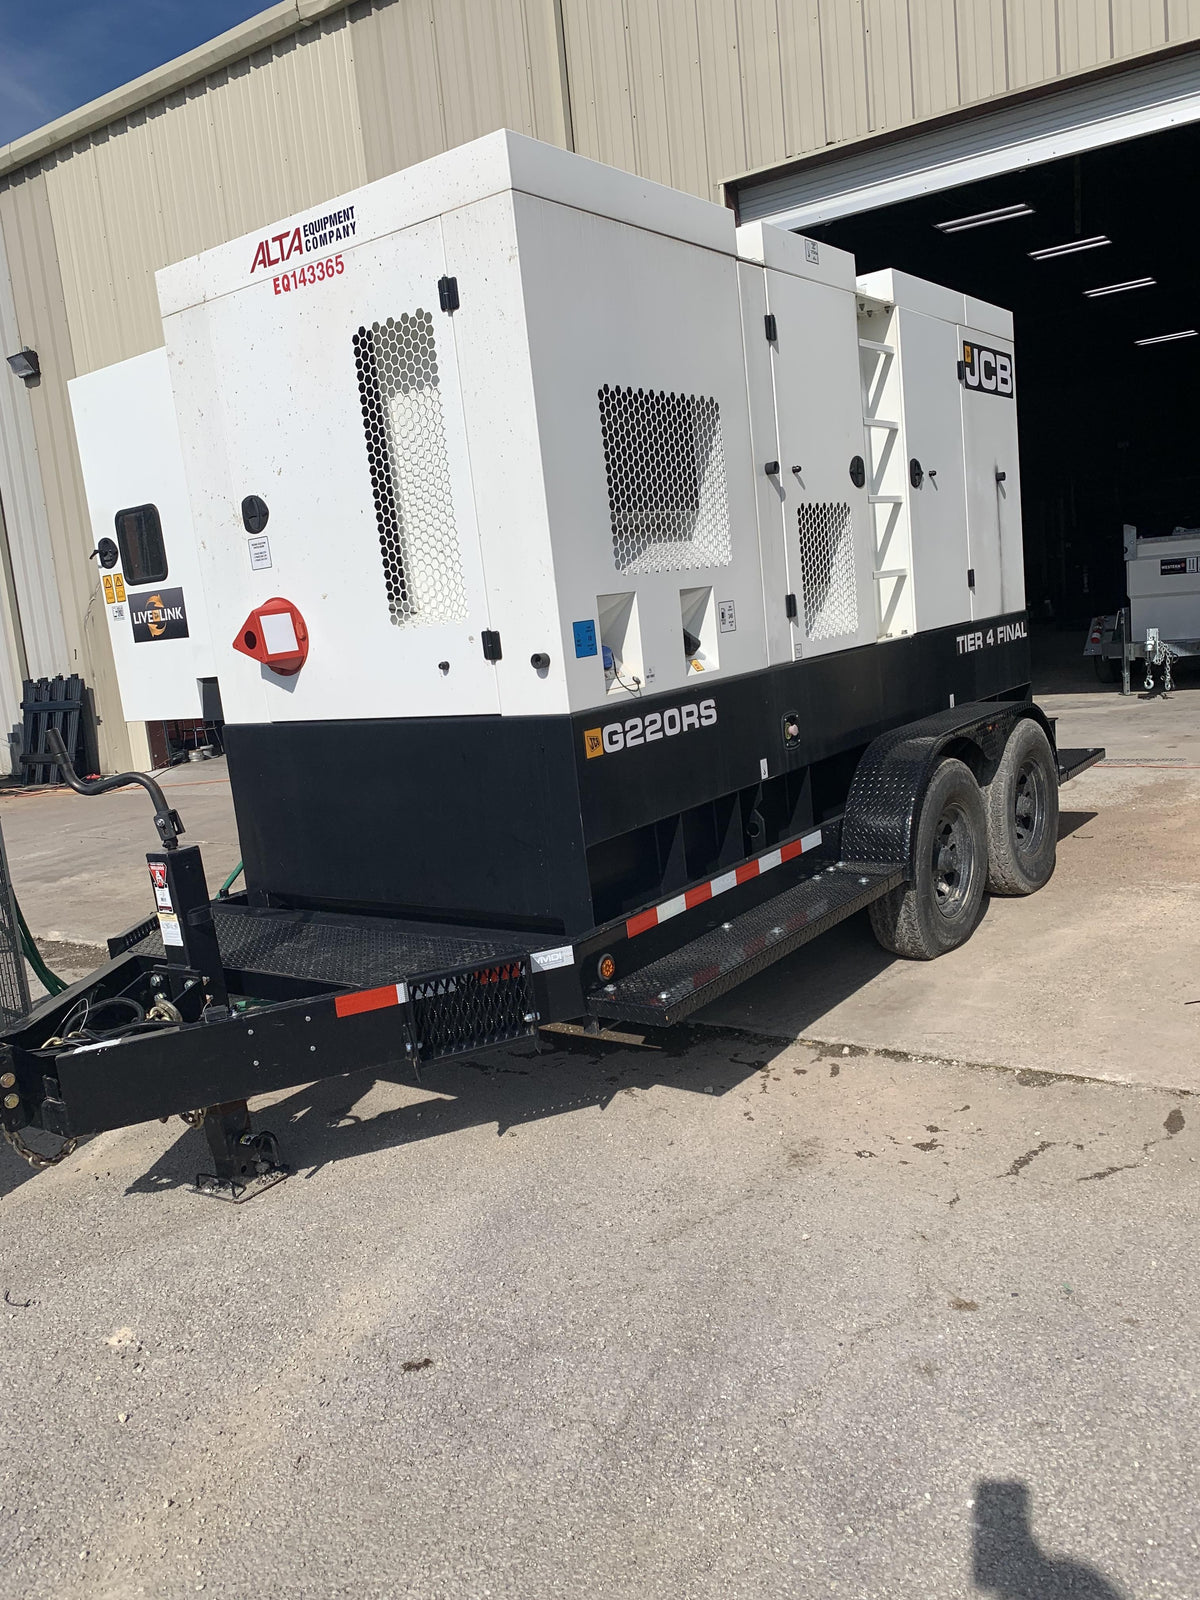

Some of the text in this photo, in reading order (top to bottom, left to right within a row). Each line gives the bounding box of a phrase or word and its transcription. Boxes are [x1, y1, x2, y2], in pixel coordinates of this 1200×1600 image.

[303, 205, 355, 238] EQUIPMENT
[305, 221, 356, 252] COMPANY
[250, 227, 303, 274] ALTA
[273, 254, 344, 295] EQ143365
[965, 348, 1012, 394] JCB
[956, 621, 1028, 654] TIER 4 FINAL
[602, 698, 718, 754] G220RS
